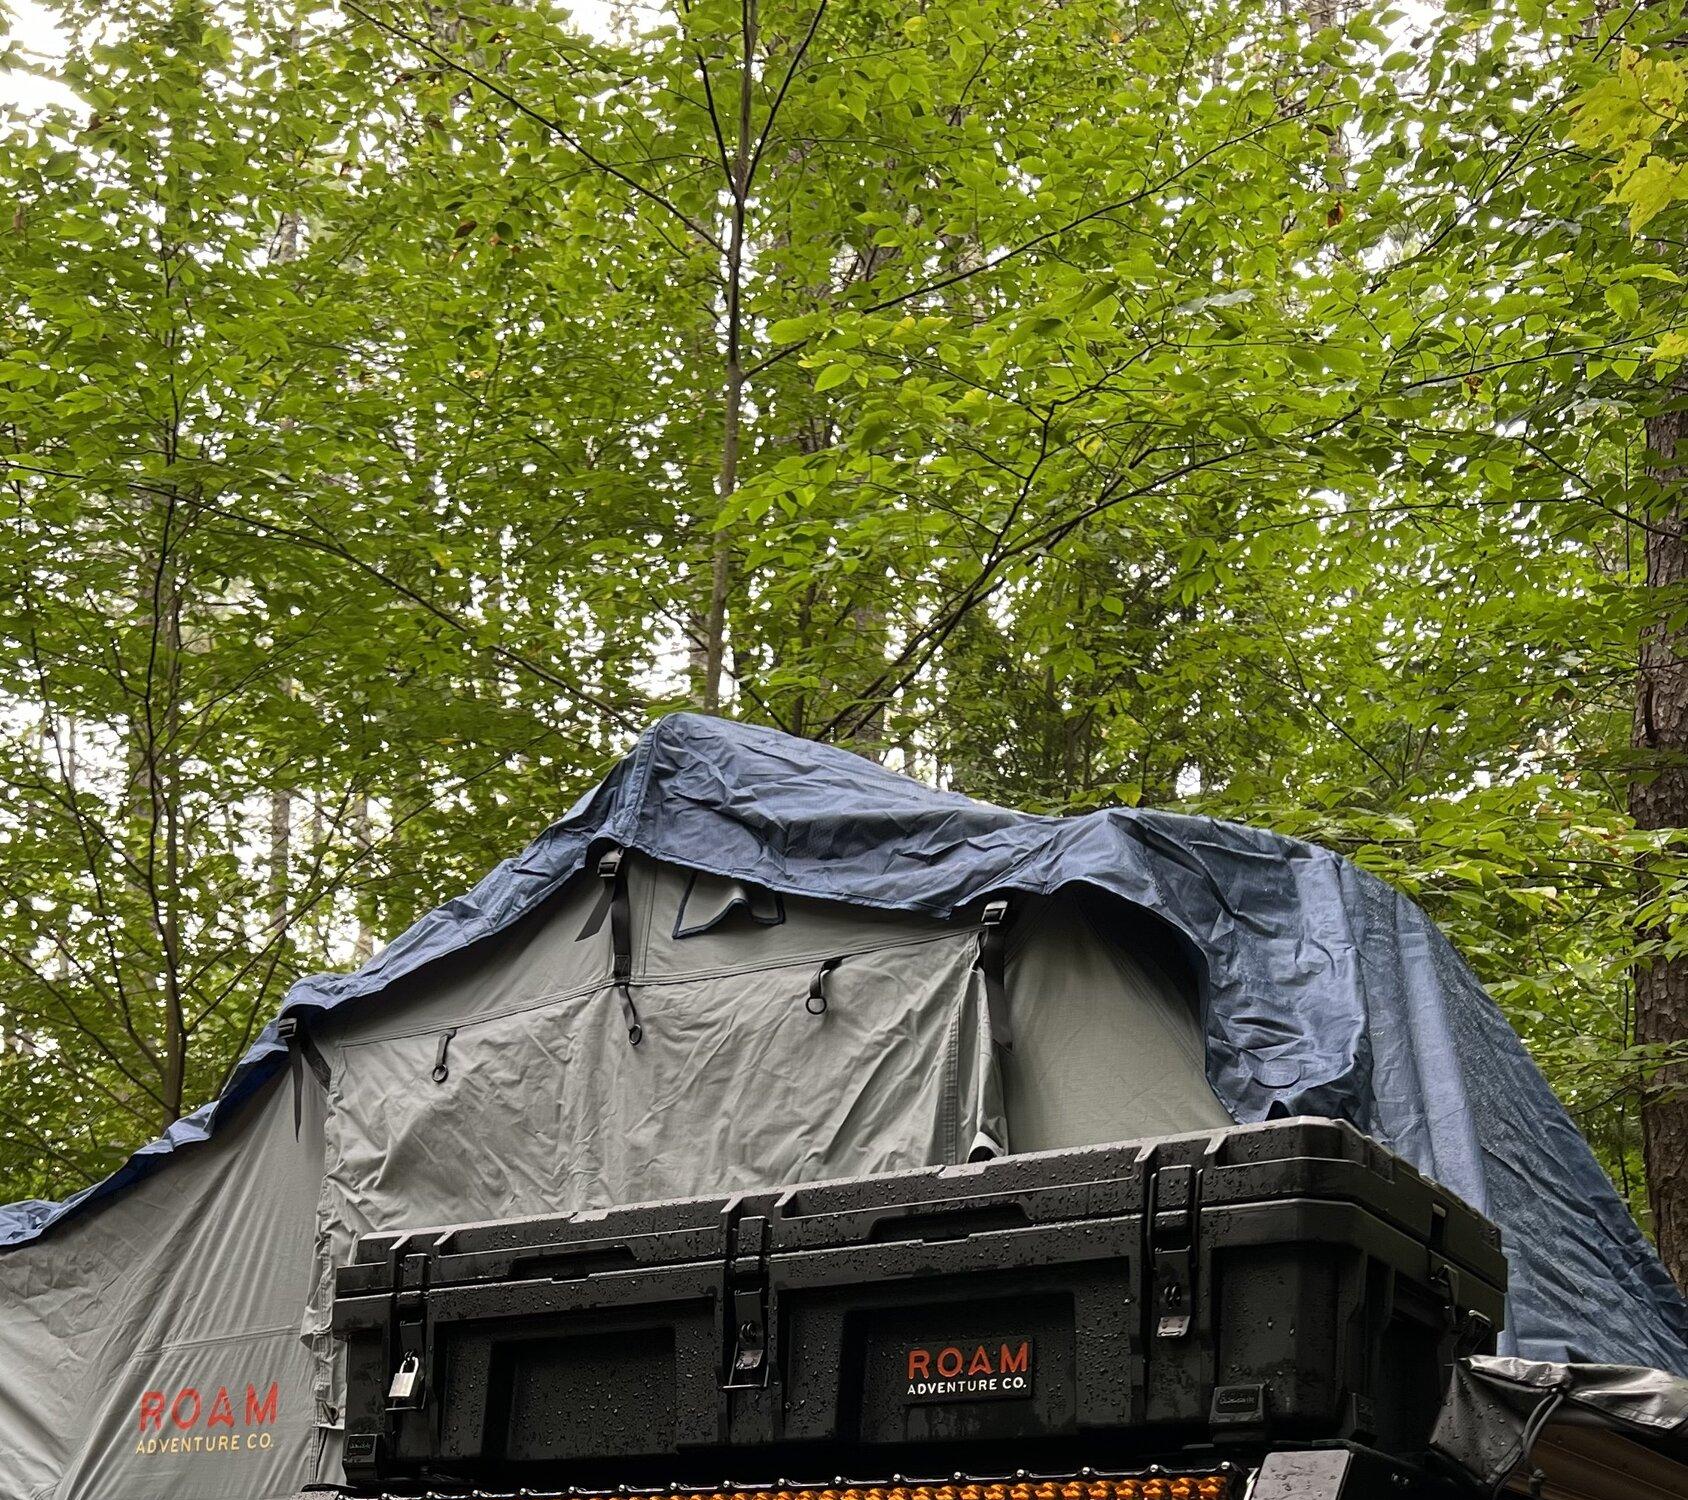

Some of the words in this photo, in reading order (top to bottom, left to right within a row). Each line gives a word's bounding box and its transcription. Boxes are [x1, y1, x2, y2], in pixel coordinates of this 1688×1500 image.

[907, 1342, 1030, 1379] ROAM
[907, 1379, 997, 1395] ADVENTURE
[1002, 1377, 1027, 1390] CO.
[138, 1381, 279, 1431] ROAM
[135, 1434, 240, 1454] ADVENTURE
[247, 1432, 274, 1449] CO.
